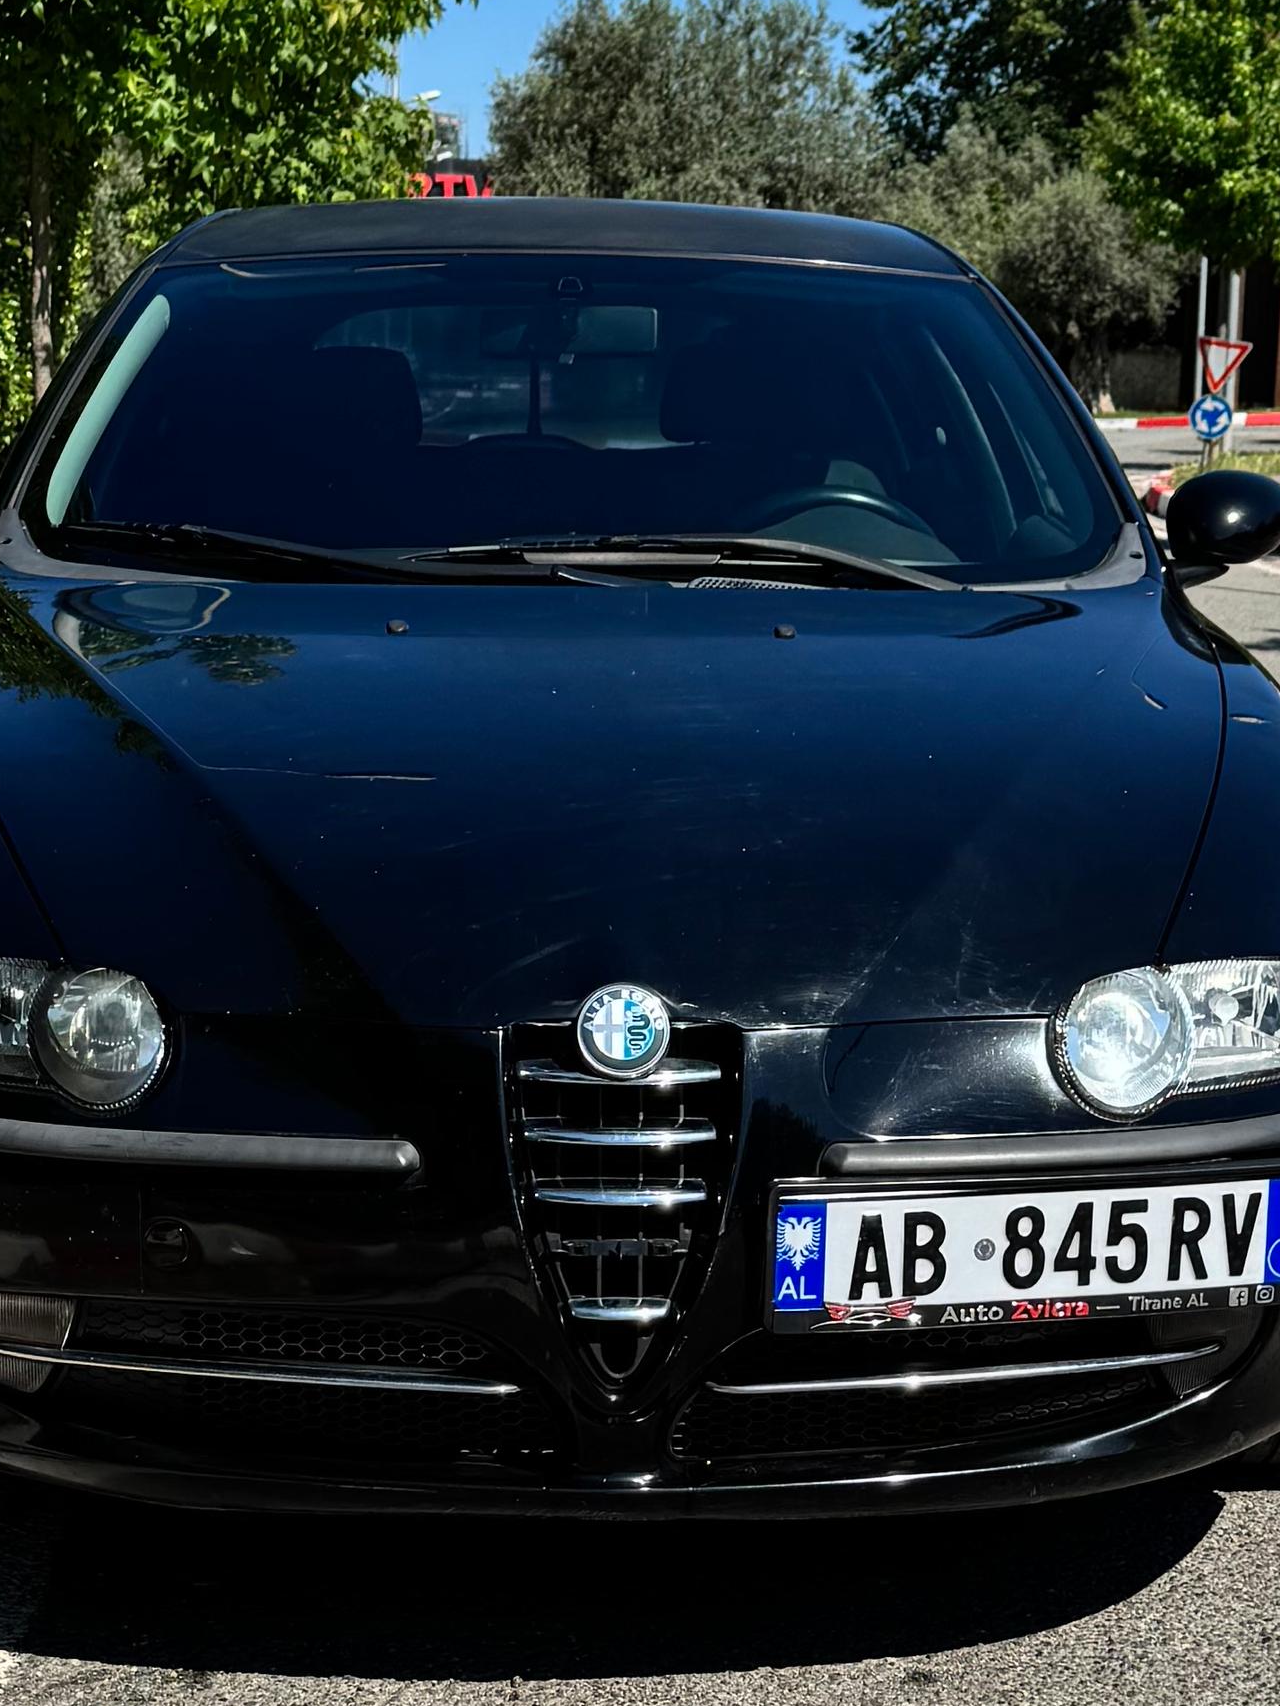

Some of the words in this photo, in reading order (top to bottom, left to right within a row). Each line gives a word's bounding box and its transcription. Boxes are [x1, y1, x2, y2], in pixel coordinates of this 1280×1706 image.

[583, 994, 614, 1030] ALFA
[847, 1211, 947, 1300] AB
[1001, 1199, 1150, 1290] 845
[1167, 1192, 1263, 1282] RV
[778, 1276, 817, 1302] AL
[939, 1305, 1004, 1324] Auto
[1186, 1293, 1209, 1308] AL
